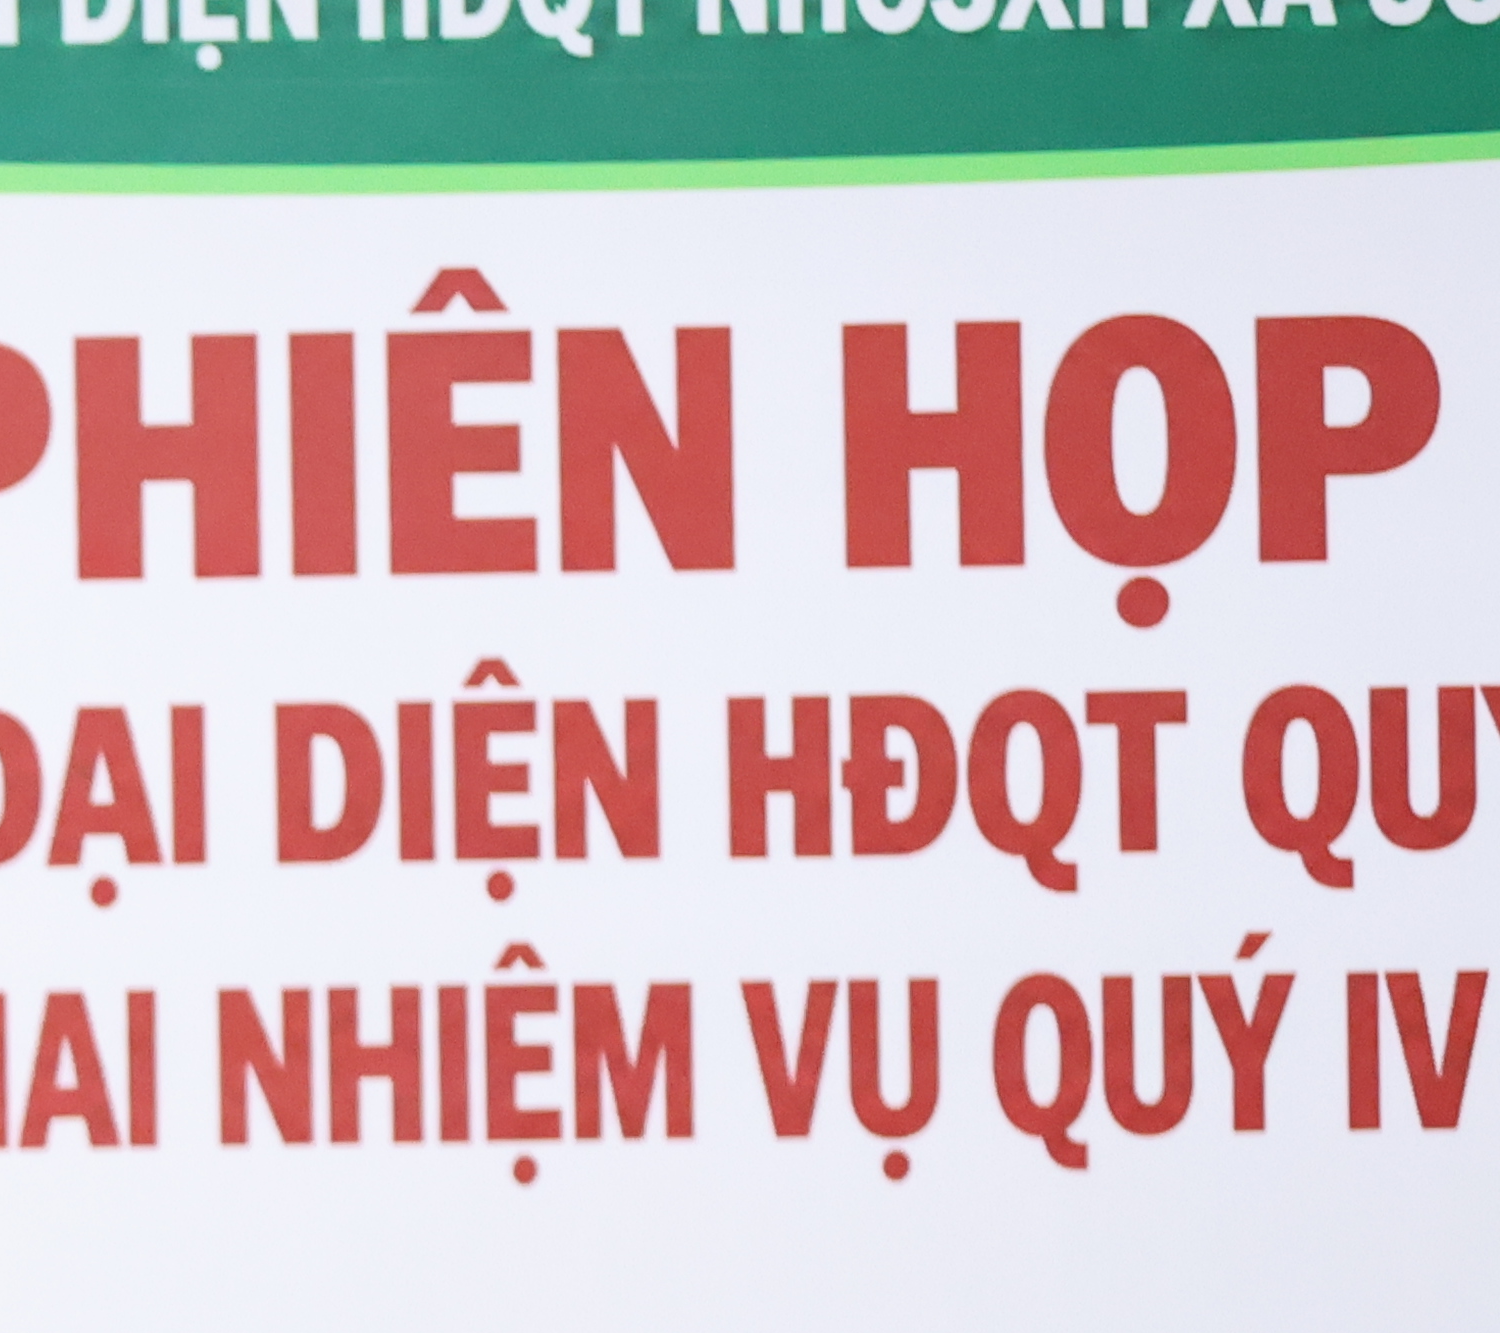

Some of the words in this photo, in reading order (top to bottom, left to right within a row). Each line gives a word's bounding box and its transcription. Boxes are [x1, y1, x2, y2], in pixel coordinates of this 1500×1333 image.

[842, 314, 1442, 630] HỌP
[275, 658, 662, 902] DIỆN
[727, 689, 1188, 893] HĐQT
[1242, 683, 1500, 890] QU
[219, 943, 695, 1185] NHIỆM
[740, 978, 941, 1182] VỤ
[992, 931, 1296, 1170] QUÝ
[1346, 969, 1489, 1131] IV
